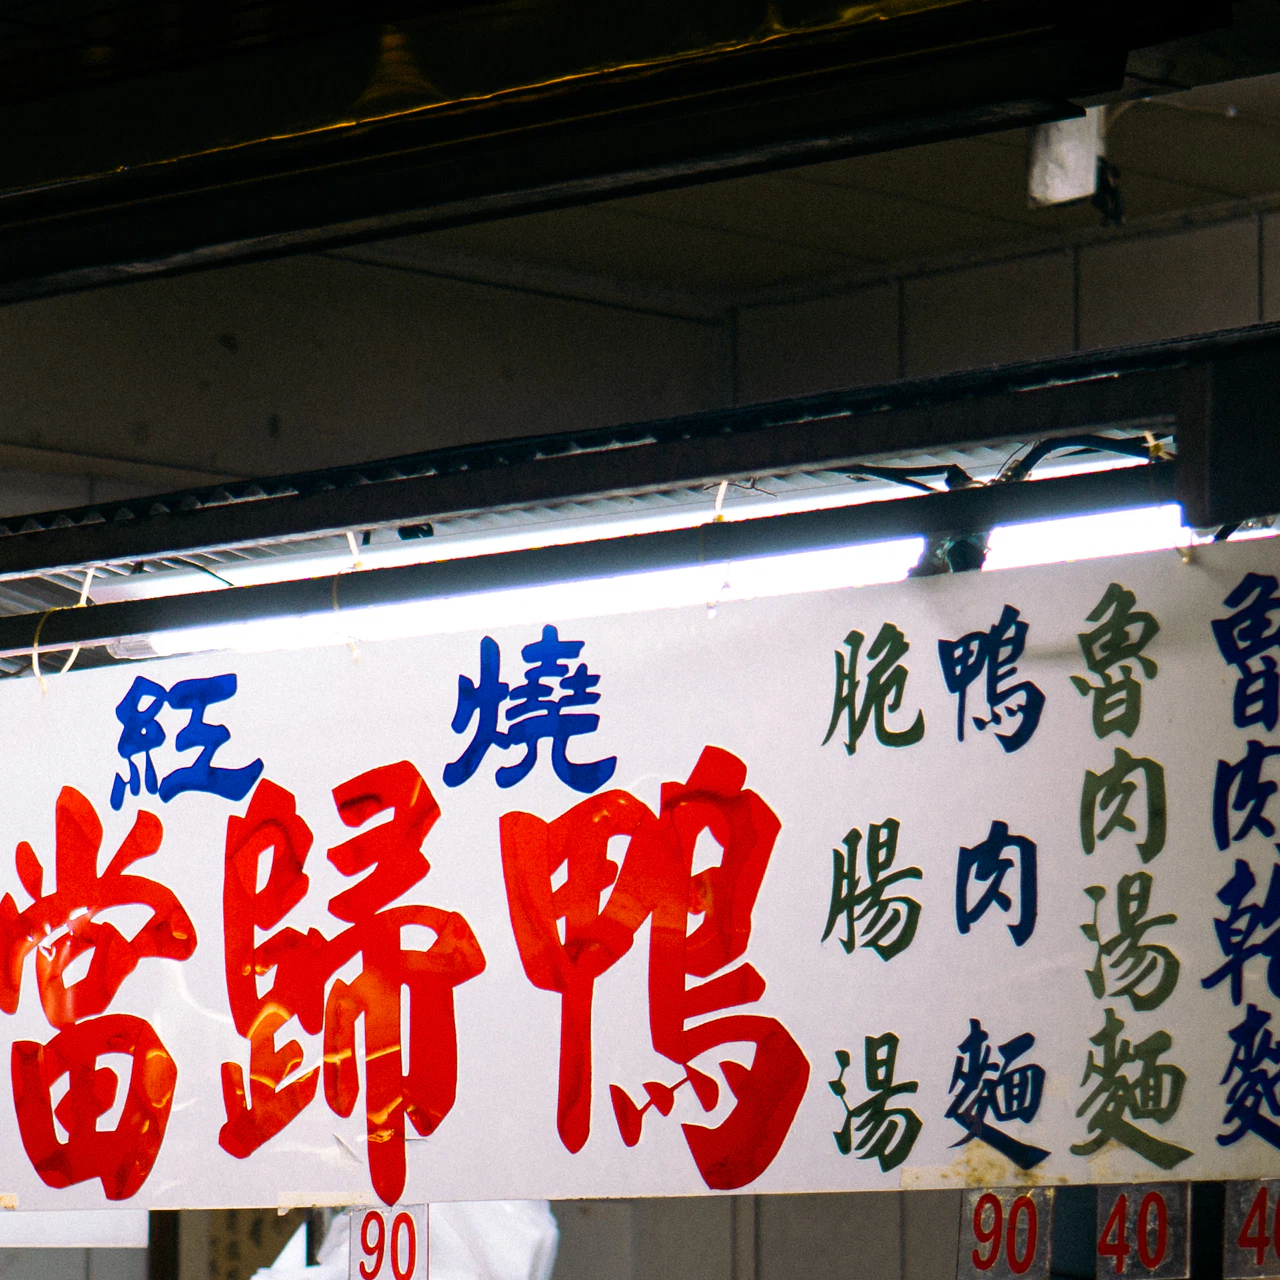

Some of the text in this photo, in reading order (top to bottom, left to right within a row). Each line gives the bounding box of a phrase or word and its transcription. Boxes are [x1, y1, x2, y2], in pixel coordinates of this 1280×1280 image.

[110, 625, 617, 811] 紅燒
[821, 622, 925, 1172] 脆腸湯
[938, 604, 1052, 1169] 鴨肉麵
[1070, 582, 1194, 1170] 魯肉湯麵
[972, 1193, 1038, 1275] 90
[1097, 1191, 1169, 1274] 40
